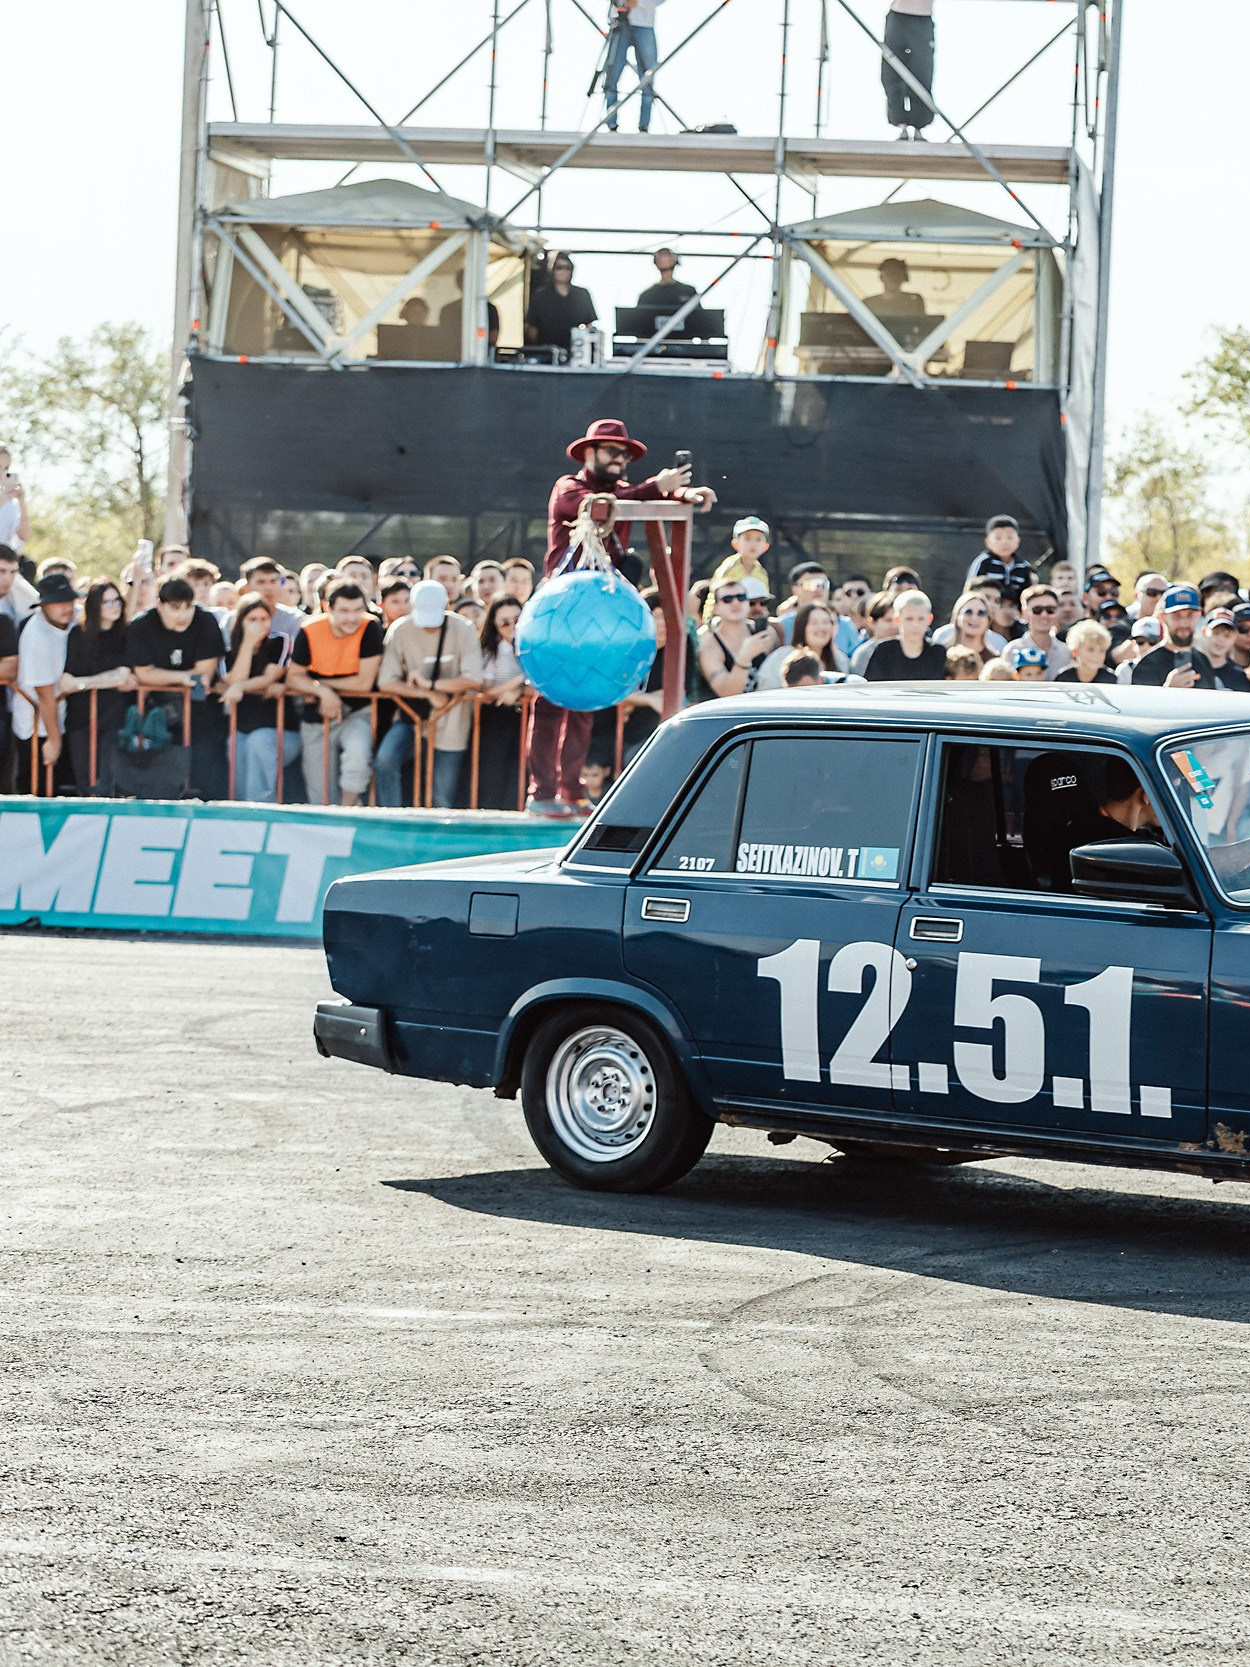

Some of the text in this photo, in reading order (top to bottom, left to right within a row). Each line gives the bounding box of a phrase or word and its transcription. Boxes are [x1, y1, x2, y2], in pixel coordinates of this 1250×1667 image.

[0, 812, 356, 923] MEET
[679, 856, 716, 872] 2107
[736, 842, 859, 878] SEITKAZINOV. T
[757, 938, 1172, 1118] 12.5.1.
